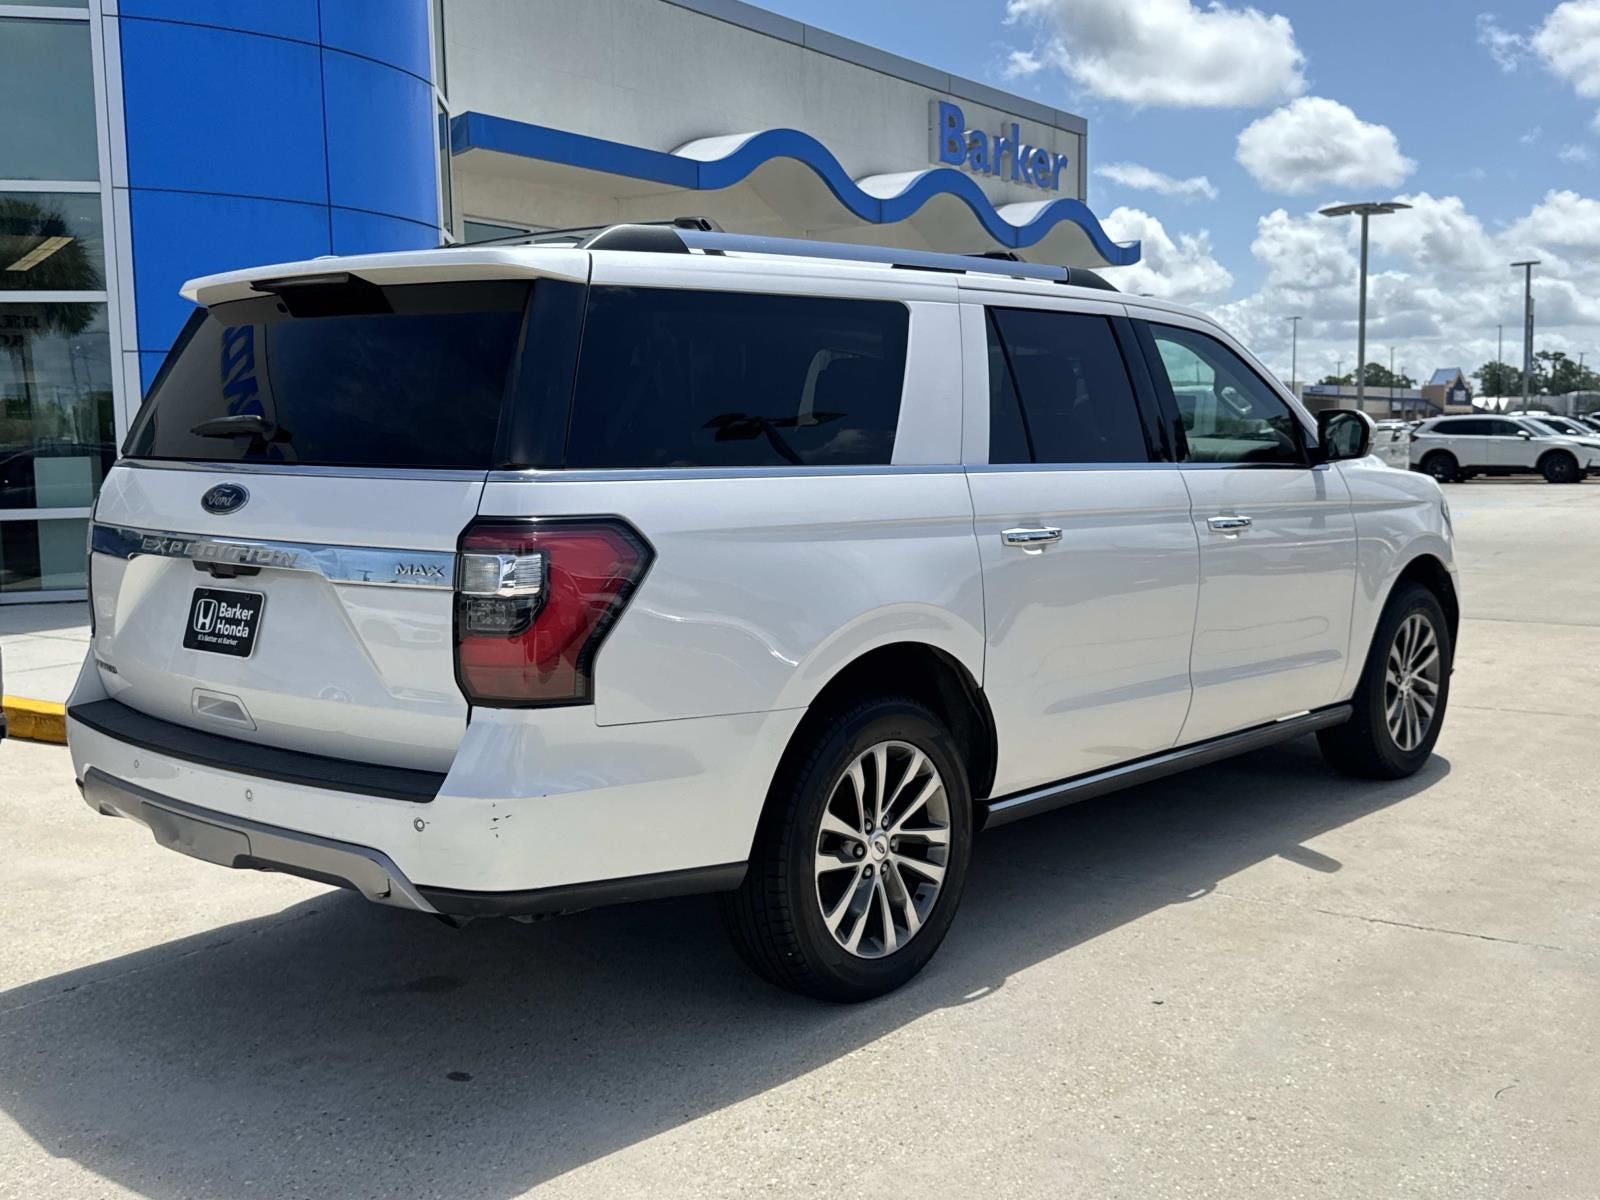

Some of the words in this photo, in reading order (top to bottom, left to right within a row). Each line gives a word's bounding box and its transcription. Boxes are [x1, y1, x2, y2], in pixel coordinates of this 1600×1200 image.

[938, 100, 1068, 191] Barker
[141, 537, 298, 568] EXPEDITION
[395, 562, 445, 577] MAX
[219, 602, 254, 620] Barker
[215, 619, 249, 638] Honda
